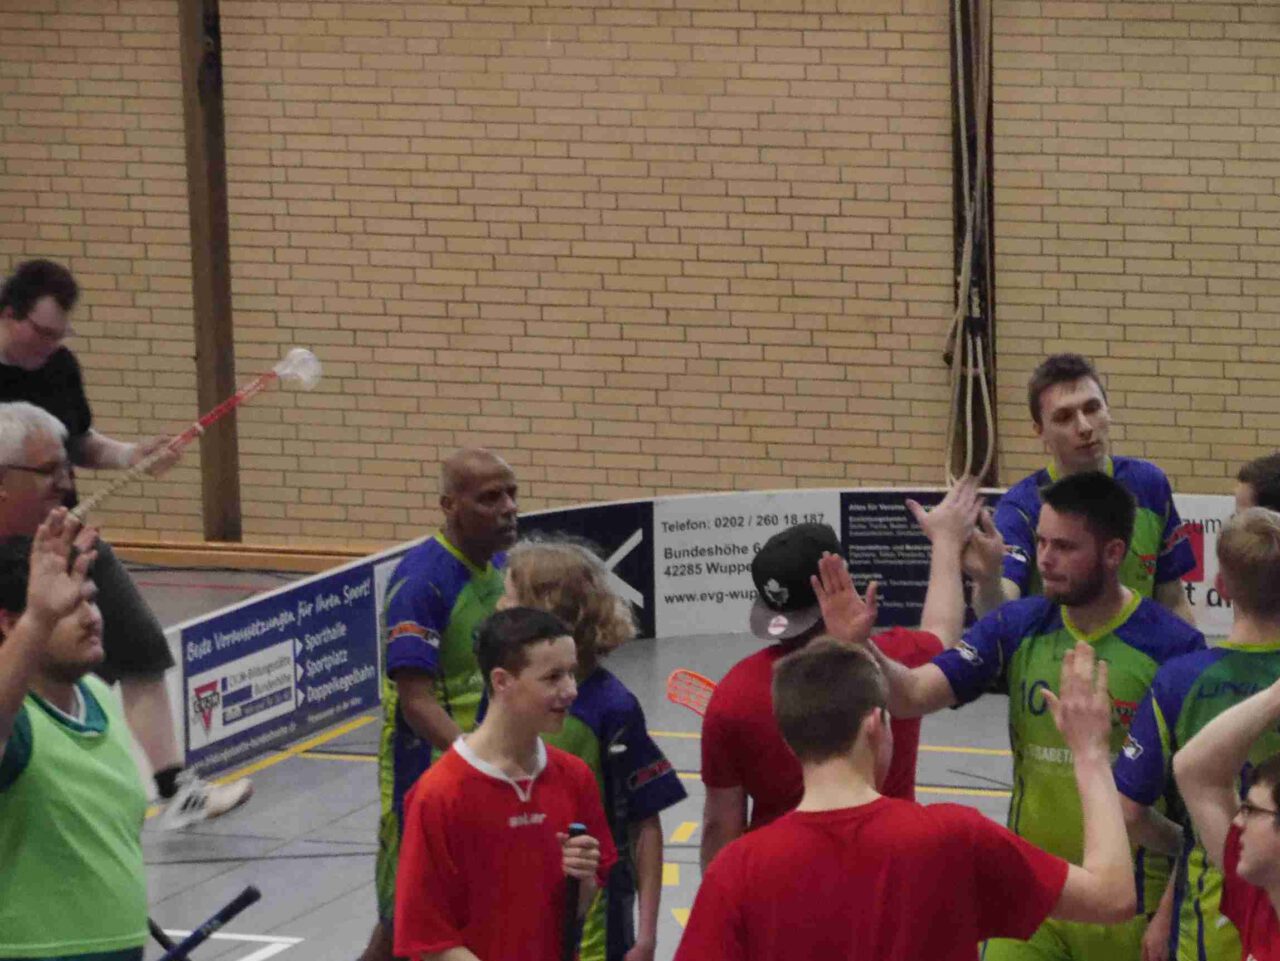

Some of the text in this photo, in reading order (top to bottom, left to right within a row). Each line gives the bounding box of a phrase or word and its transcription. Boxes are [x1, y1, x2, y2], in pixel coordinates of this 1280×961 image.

[661, 518, 711, 533] Telefon:
[714, 516, 745, 529] 0202
[756, 515, 779, 527] 260
[783, 514, 798, 525] 18
[803, 513, 825, 524] 187
[663, 543, 749, 560] Bundeshöhe
[663, 562, 753, 578] 42285 Wuppe
[664, 589, 759, 604] www.evg-wup
[304, 621, 347, 652] Sporthalle
[305, 650, 348, 678] Sportplatz
